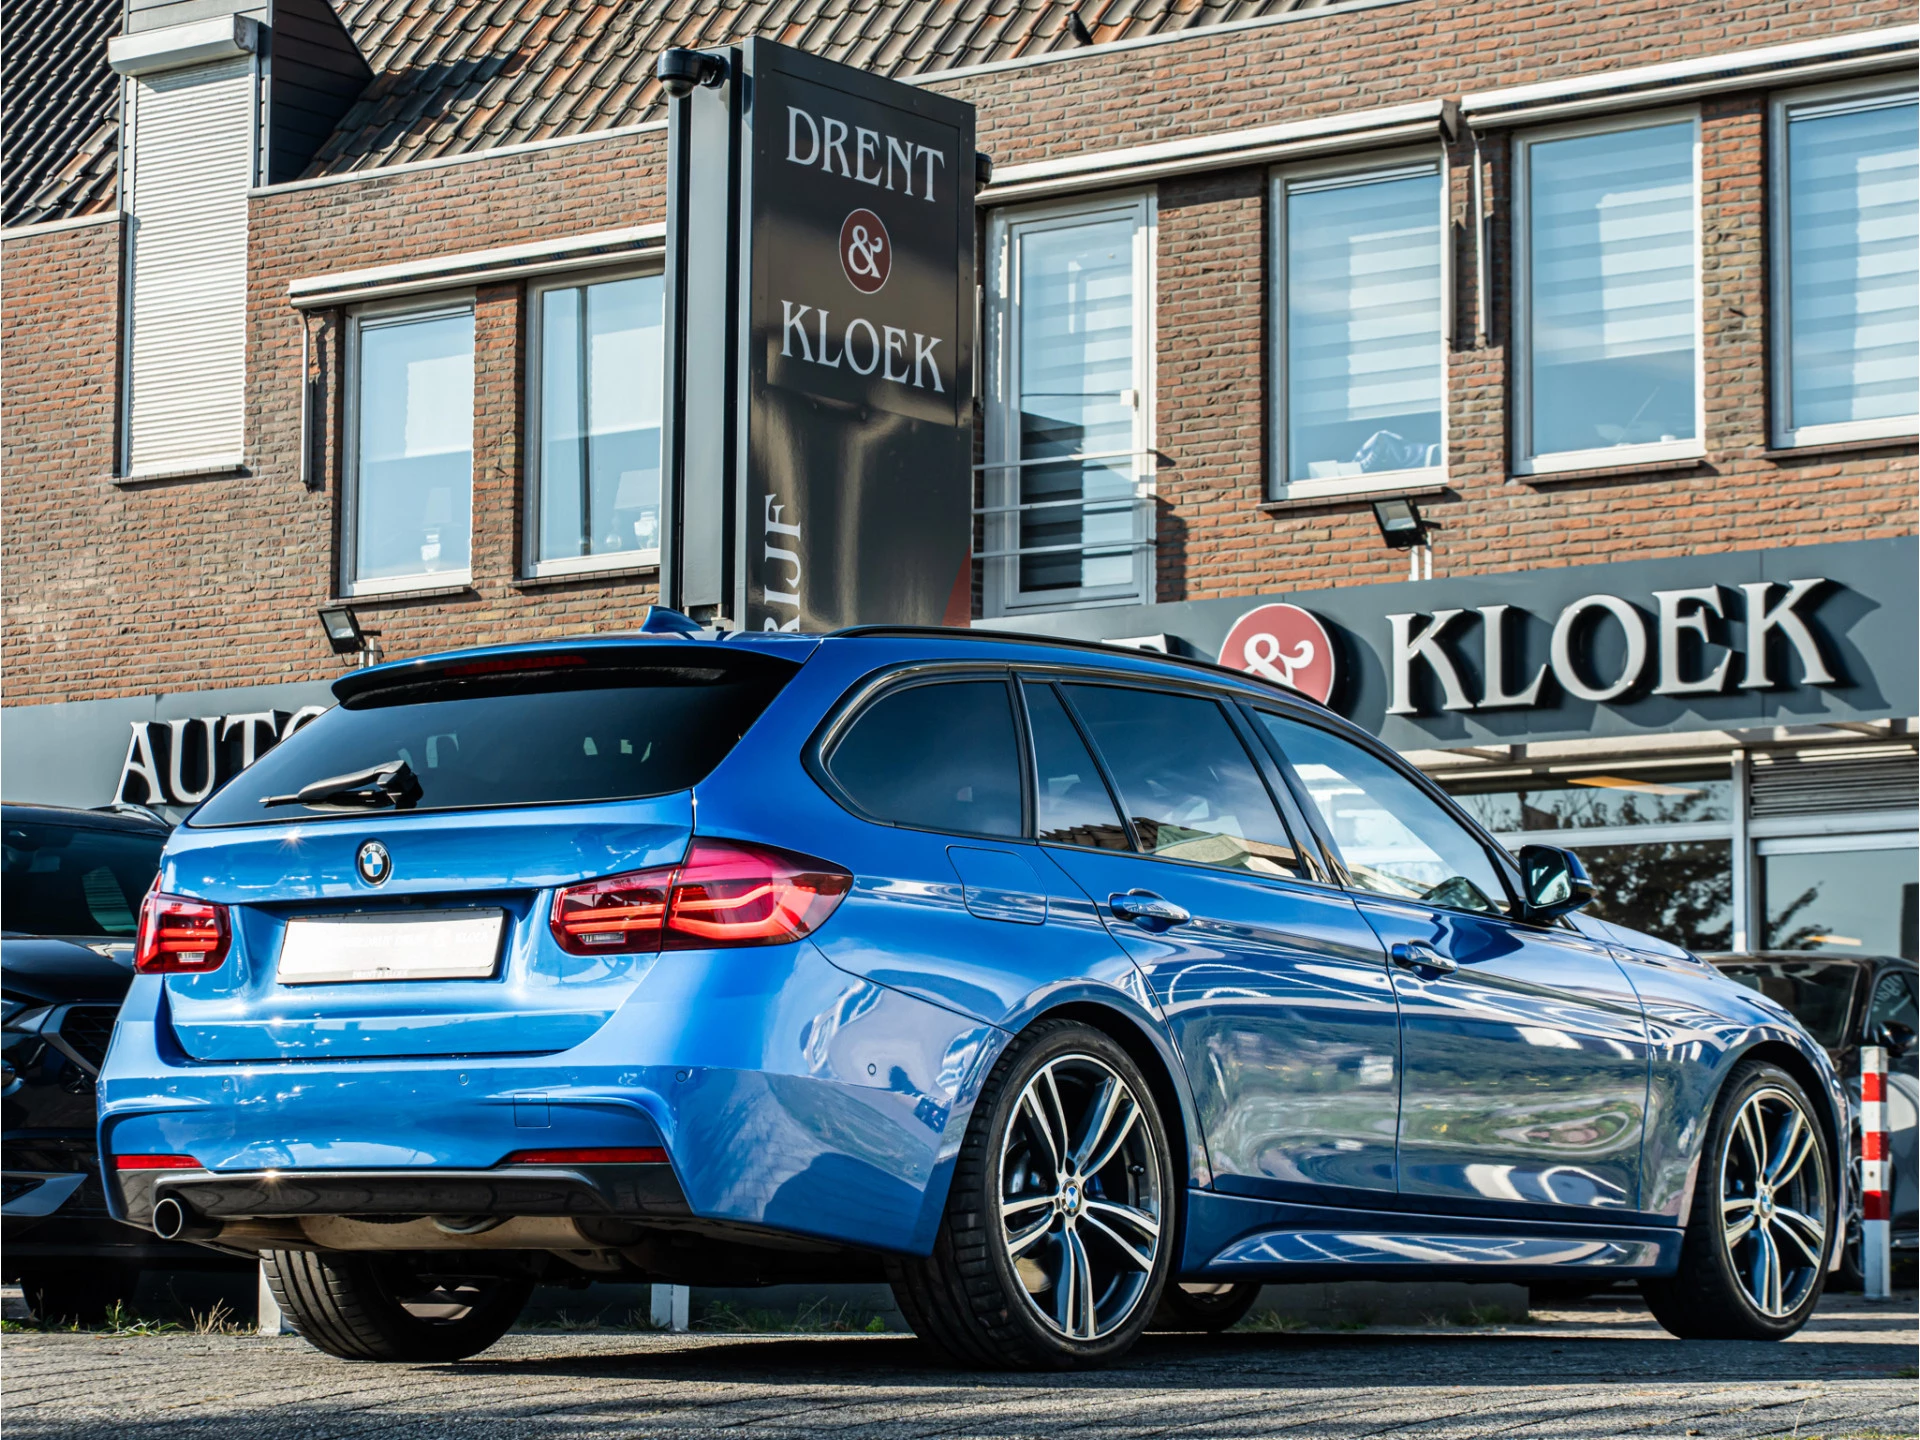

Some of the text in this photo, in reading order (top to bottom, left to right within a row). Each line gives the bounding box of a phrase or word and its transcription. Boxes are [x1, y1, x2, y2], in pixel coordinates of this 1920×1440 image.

[785, 105, 945, 202] DRENT
[847, 224, 884, 279] &
[779, 299, 946, 393] KLOEK
[1386, 577, 1836, 715] KLOEK
[111, 706, 327, 805] AUT
